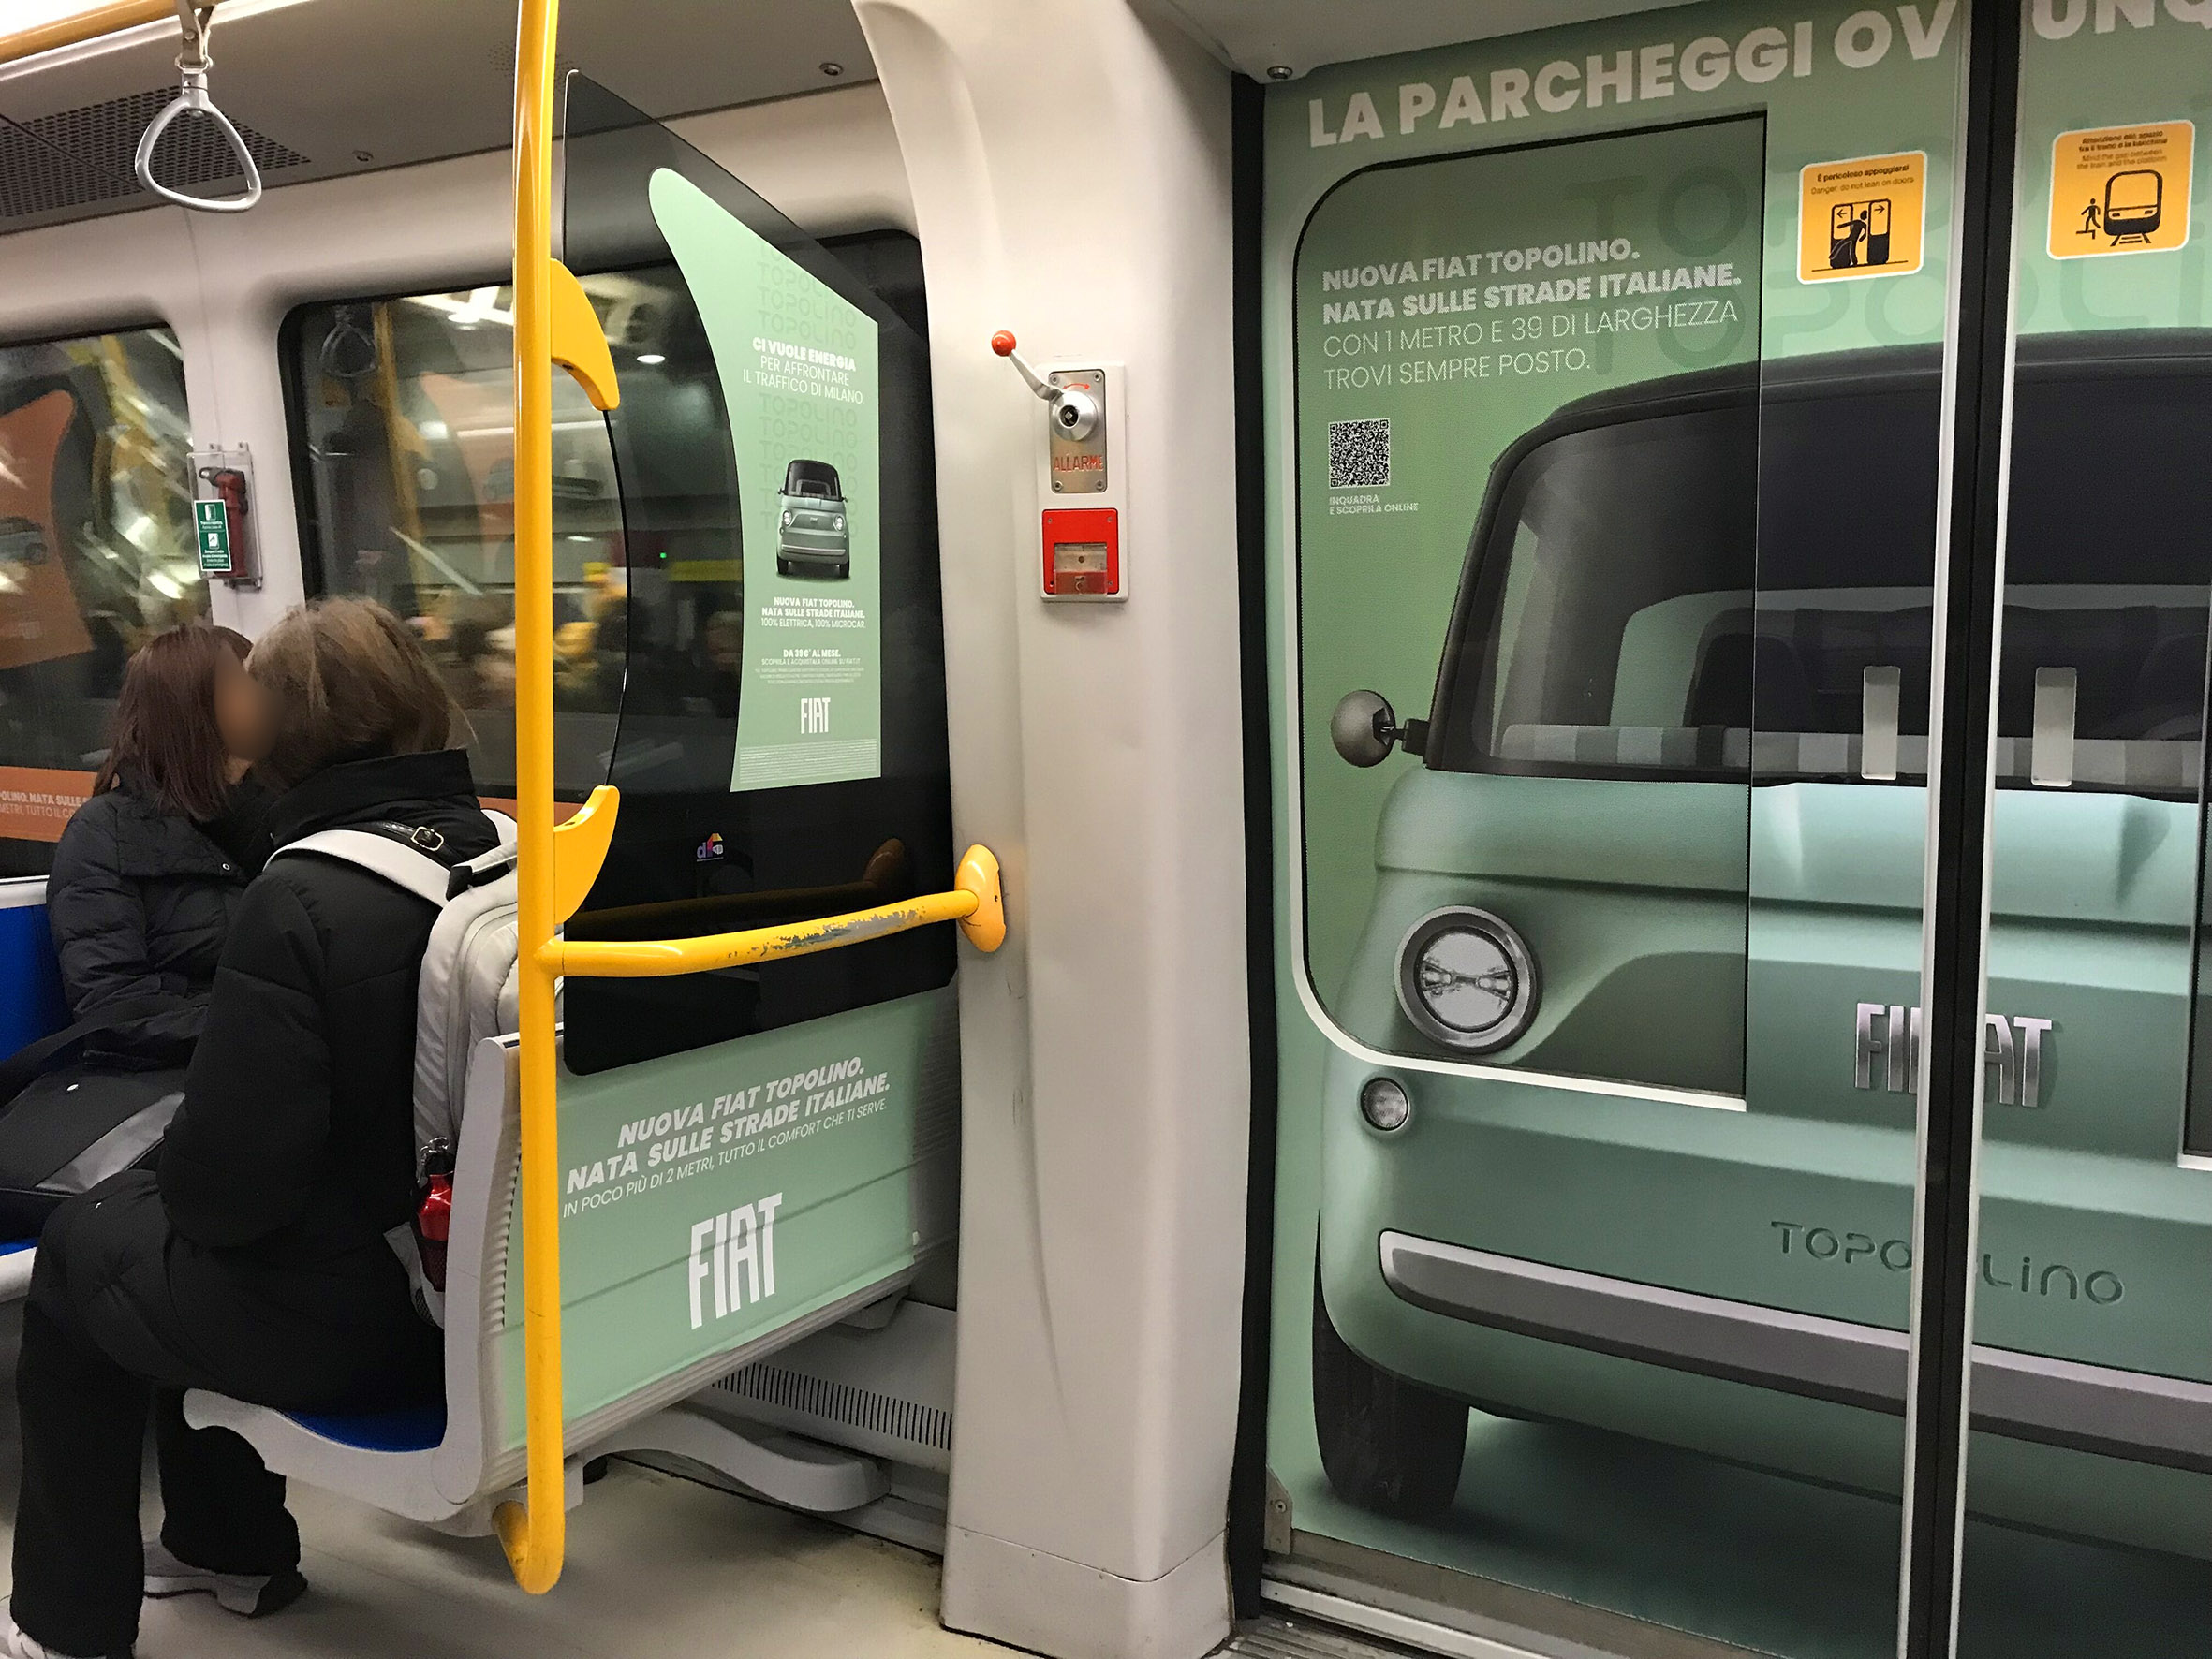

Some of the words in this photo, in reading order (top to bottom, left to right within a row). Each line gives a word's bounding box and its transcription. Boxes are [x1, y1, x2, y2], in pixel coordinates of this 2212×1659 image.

[1309, 91, 1385, 148] LA
[1399, 22, 1813, 135] PARCHEGGI
[1322, 261, 1418, 292] NUOVA
[1423, 253, 1482, 282] FIAT
[1486, 238, 1640, 274] TOPOLINO.
[1322, 297, 1395, 325] NATA
[1402, 288, 1477, 317] SULLE
[1484, 276, 1591, 309] STRADE
[1600, 262, 1742, 298] ITALIANE.
[1323, 331, 1378, 357] CON
[1385, 330, 1392, 352] 1
[1400, 323, 1482, 350] METRO
[1491, 320, 1503, 343] E
[1512, 316, 1543, 341] 39
[1552, 314, 1575, 337] DI
[1585, 300, 1738, 334] LARGHEZZA
[752, 336, 766, 353] CI
[768, 339, 807, 361] VUOLE
[808, 348, 856, 372] ENERGIA
[760, 355, 780, 372] PER
[784, 360, 849, 387] AFFRONTARE
[1323, 364, 1391, 390] TROVI
[1399, 356, 1491, 384] SEMPRE
[1499, 347, 1590, 376] POSTO.
[743, 368, 752, 384] IL
[755, 371, 808, 394] TRAFFICO
[811, 382, 821, 397] DI
[824, 385, 865, 405] MILANO.
[1054, 455, 1104, 472] ALLARME
[1330, 494, 1379, 506] INQUADRA
[1330, 507, 1335, 515] E
[761, 607, 783, 617] NATA
[784, 608, 805, 617] SULLE
[806, 608, 833, 618] STRADE
[833, 609, 866, 619] ITALIANE.
[774, 596, 801, 607] NUOVA
[802, 597, 818, 608] FIAT
[818, 598, 855, 609] TOPOLINO.
[761, 617, 778, 627] 100%
[779, 618, 814, 628] ELETTRICA,
[815, 619, 831, 628] 100%
[783, 649, 794, 657] DA
[812, 649, 820, 657] AL
[821, 649, 841, 657] MESE.
[801, 697, 831, 734] FIAT
[617, 1102, 704, 1149] NUOVA
[711, 1085, 760, 1120] FIAT
[766, 1056, 864, 1103] TOPOLINO.
[567, 1152, 638, 1195] NATA
[647, 1127, 714, 1168] SULLE
[719, 1100, 800, 1144] STRADE
[804, 1072, 890, 1118] ITALIANE.
[563, 1200, 579, 1218] IN
[581, 1185, 623, 1213] POCO
[626, 1175, 648, 1198] PIÙ
[650, 1171, 664, 1190] DI
[665, 1167, 675, 1184] 2
[676, 1155, 715, 1180] METRI,
[718, 1141, 756, 1166] TUTTO
[757, 1137, 766, 1153] IL
[768, 1122, 821, 1150] COMFORT
[823, 1113, 844, 1132] CHE
[846, 1108, 855, 1123] TI
[856, 1098, 887, 1119] SERVE.
[688, 1192, 783, 1330] FIAT
